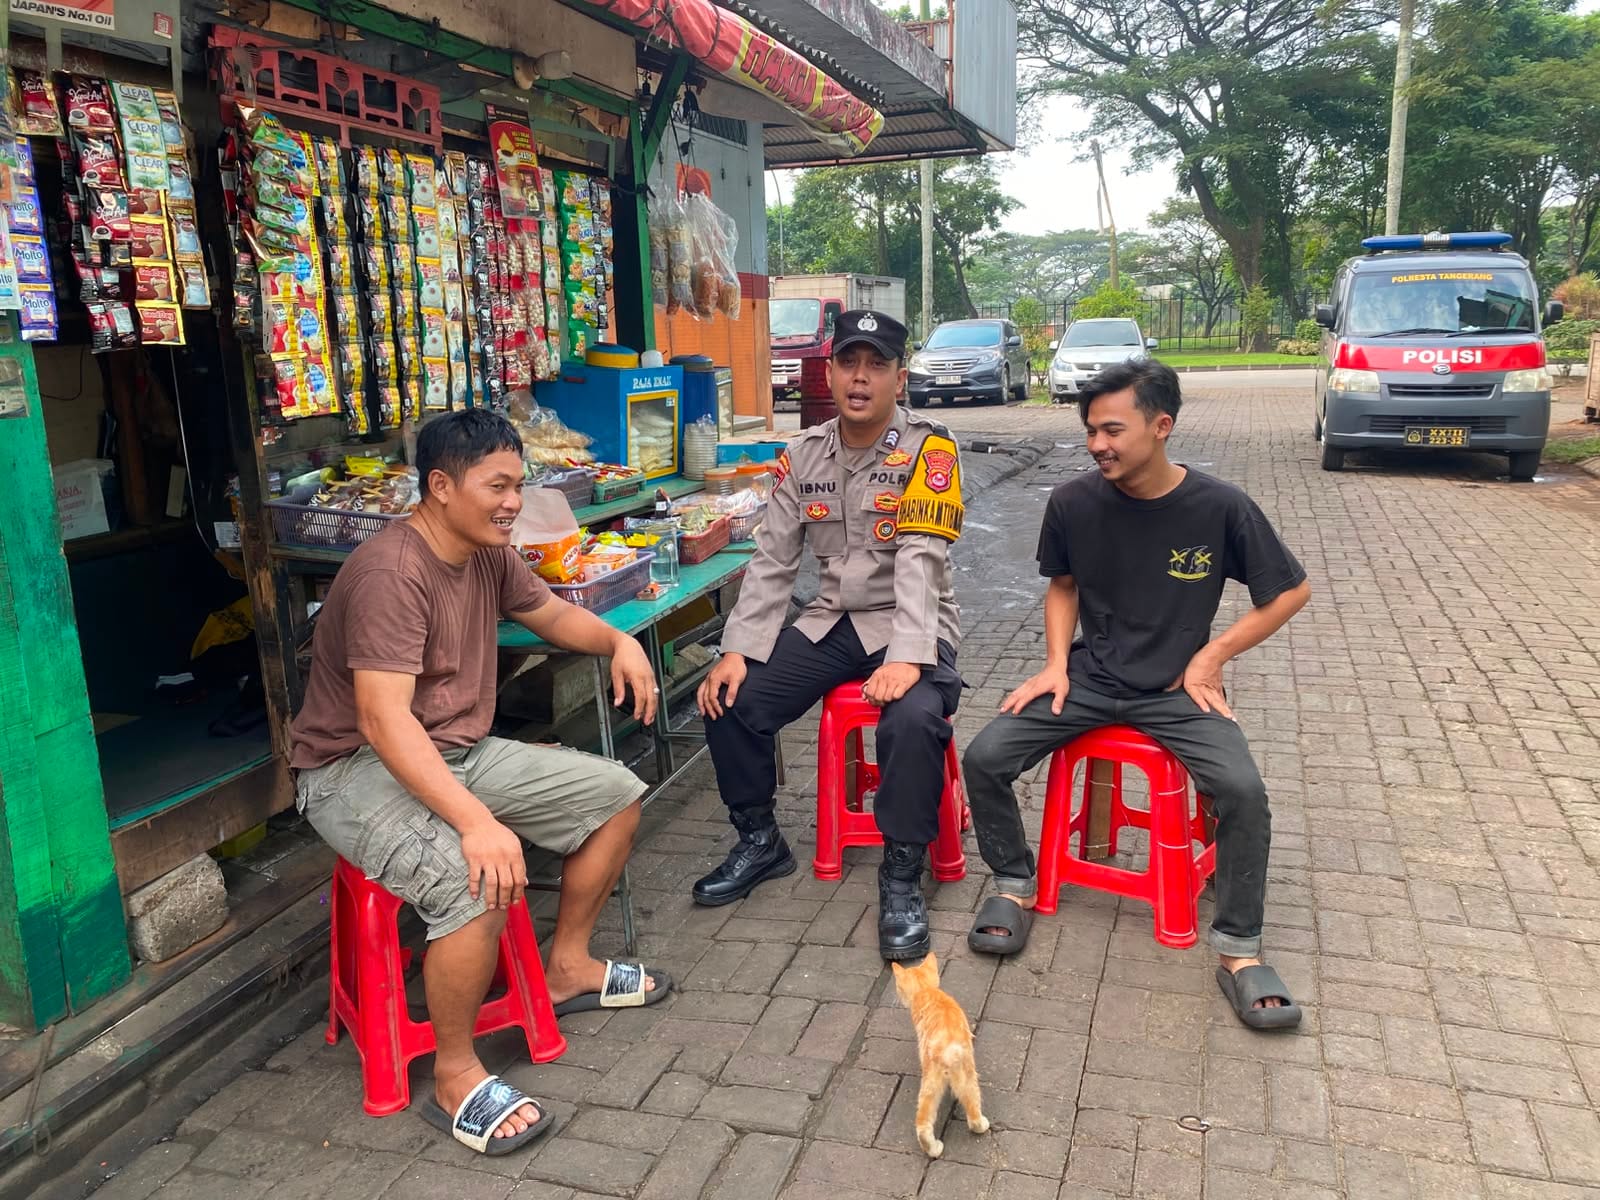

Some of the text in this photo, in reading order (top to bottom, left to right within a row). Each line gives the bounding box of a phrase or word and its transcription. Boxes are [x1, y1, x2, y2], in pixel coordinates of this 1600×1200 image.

[12, 0, 112, 26] JAPAN'S No.1 Oil
[119, 85, 150, 98] CLEAR
[127, 119, 159, 134] CLEAR
[134, 154, 164, 169] CLEAR
[15, 248, 43, 261] Molto
[1391, 272, 1493, 283] POLRESTA TANGERANG
[22, 296, 50, 309] Molto
[1402, 349, 1482, 364] POLISI
[632, 377, 652, 390] RAJA
[800, 481, 836, 494] IBNU
